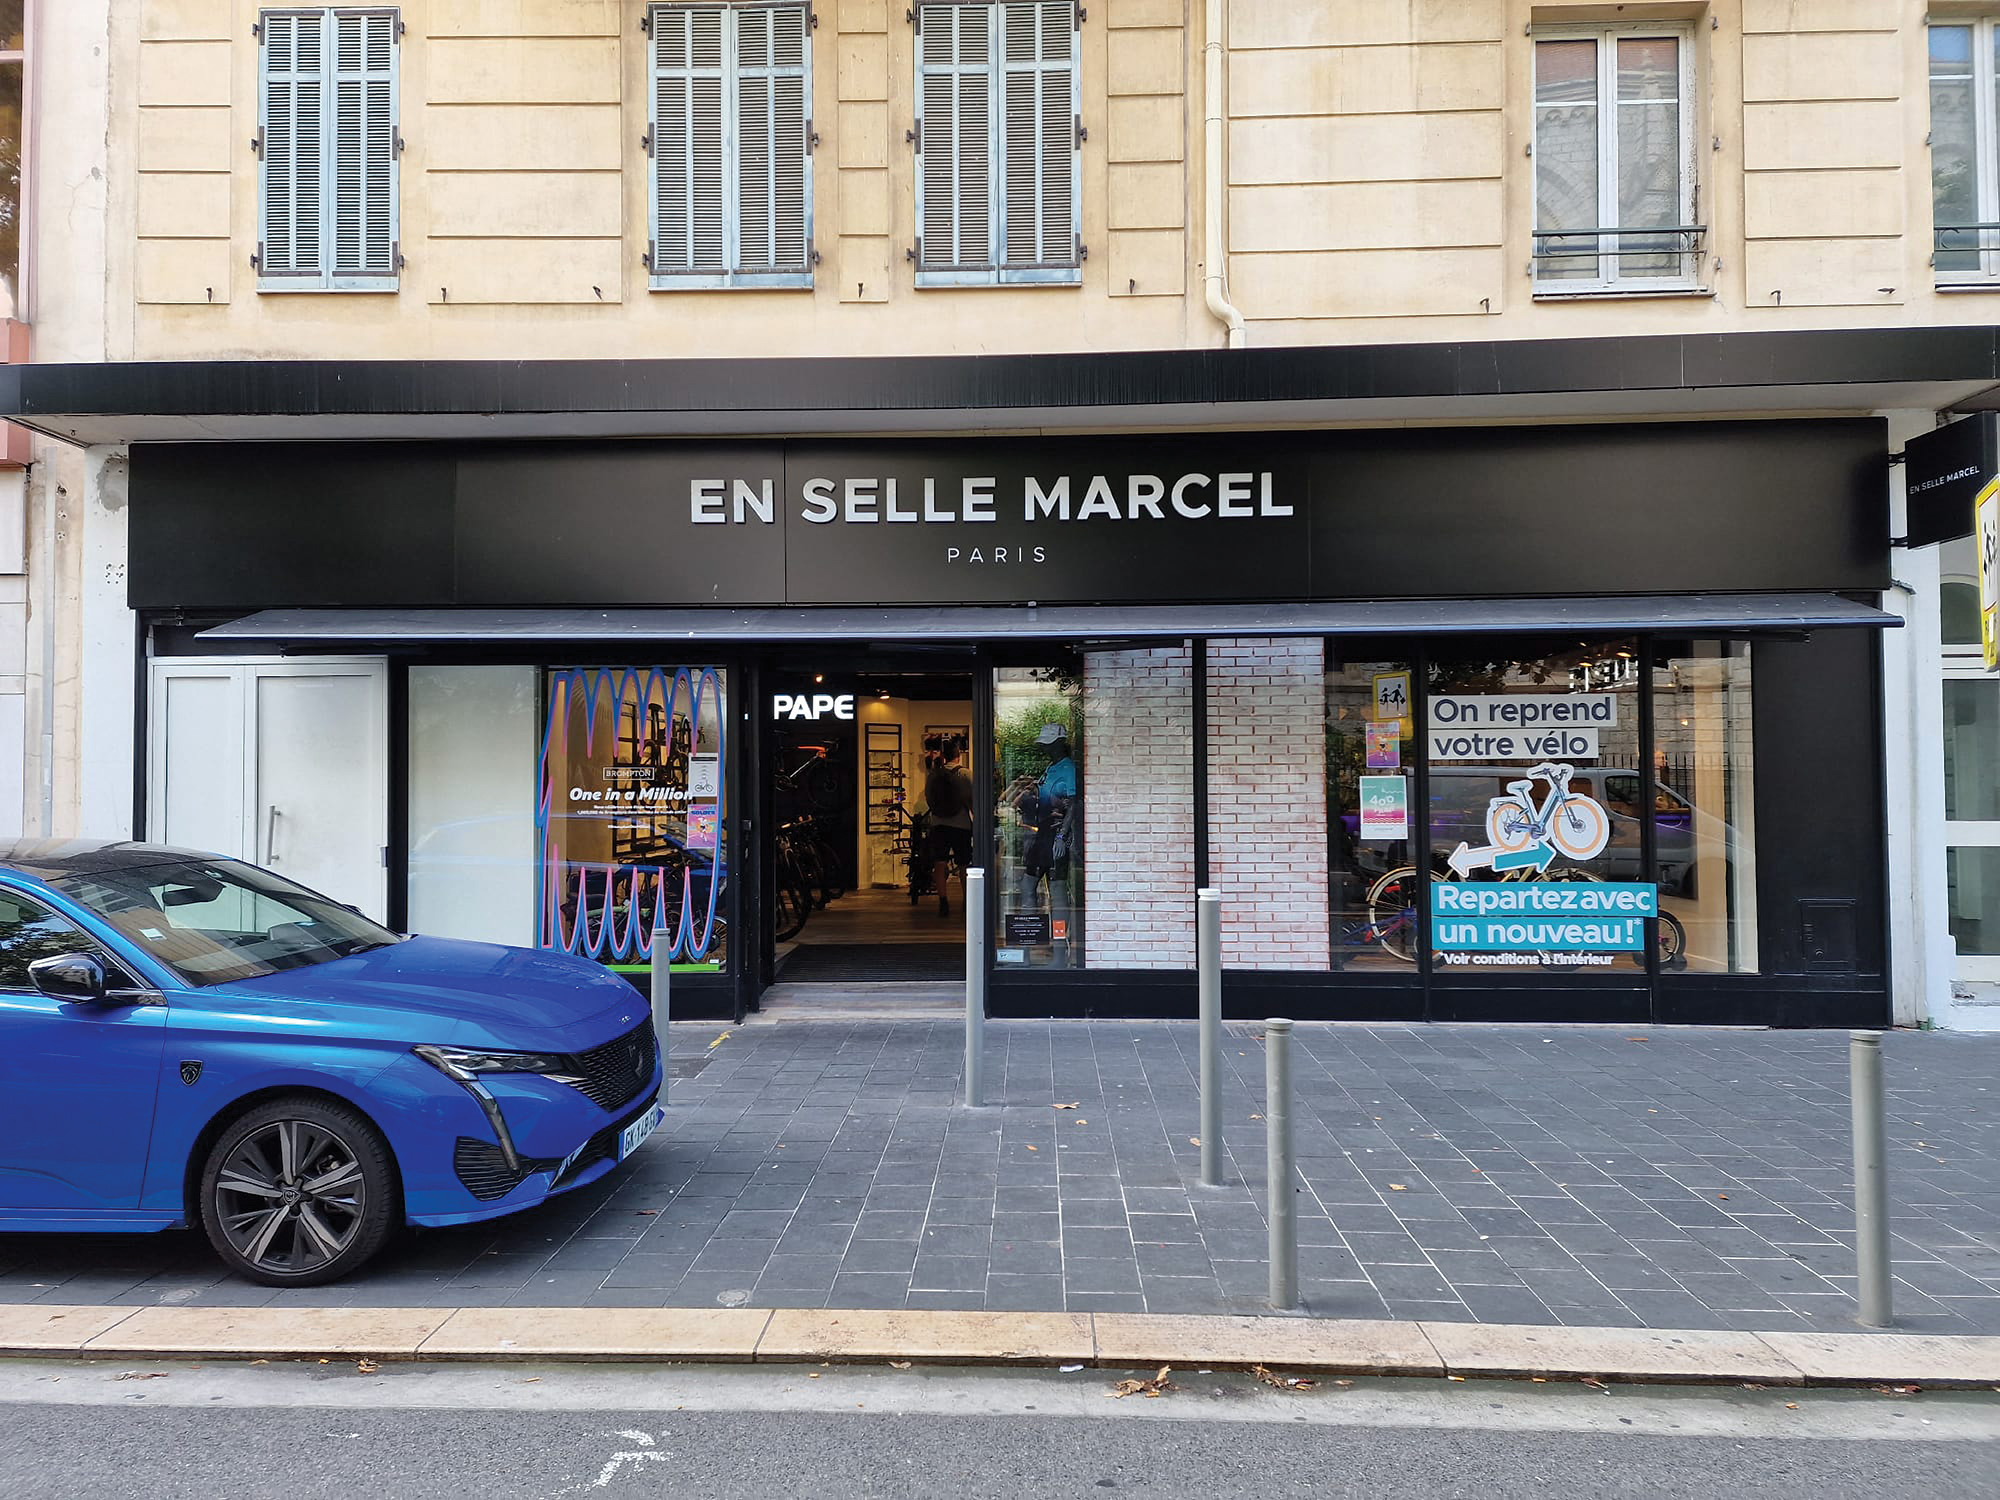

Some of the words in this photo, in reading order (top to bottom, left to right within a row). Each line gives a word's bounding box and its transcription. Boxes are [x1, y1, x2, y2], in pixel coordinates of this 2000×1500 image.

[1909, 484, 1920, 495] EN
[1921, 476, 1945, 491] SELLE
[1946, 465, 1980, 483] MARCEL
[690, 478, 775, 524] EN
[800, 476, 997, 524] SELLE
[1024, 471, 1294, 521] MARCEL
[947, 546, 1046, 563] PARIS
[773, 695, 854, 720] PAPE
[1434, 699, 1478, 723] On
[1489, 697, 1611, 727] reprend
[1434, 733, 1514, 756] votre
[1524, 730, 1588, 756] vélo
[605, 769, 651, 778] BROMPTON
[569, 787, 602, 801] One
[604, 787, 620, 801] in
[624, 790, 636, 801] a
[638, 787, 693, 801] Million
[1438, 885, 1577, 914] Repartez
[1581, 890, 1650, 910] avec
[1439, 923, 1477, 943] un
[1472, 953, 1539, 966] conditions
[1542, 952, 1551, 965] à
